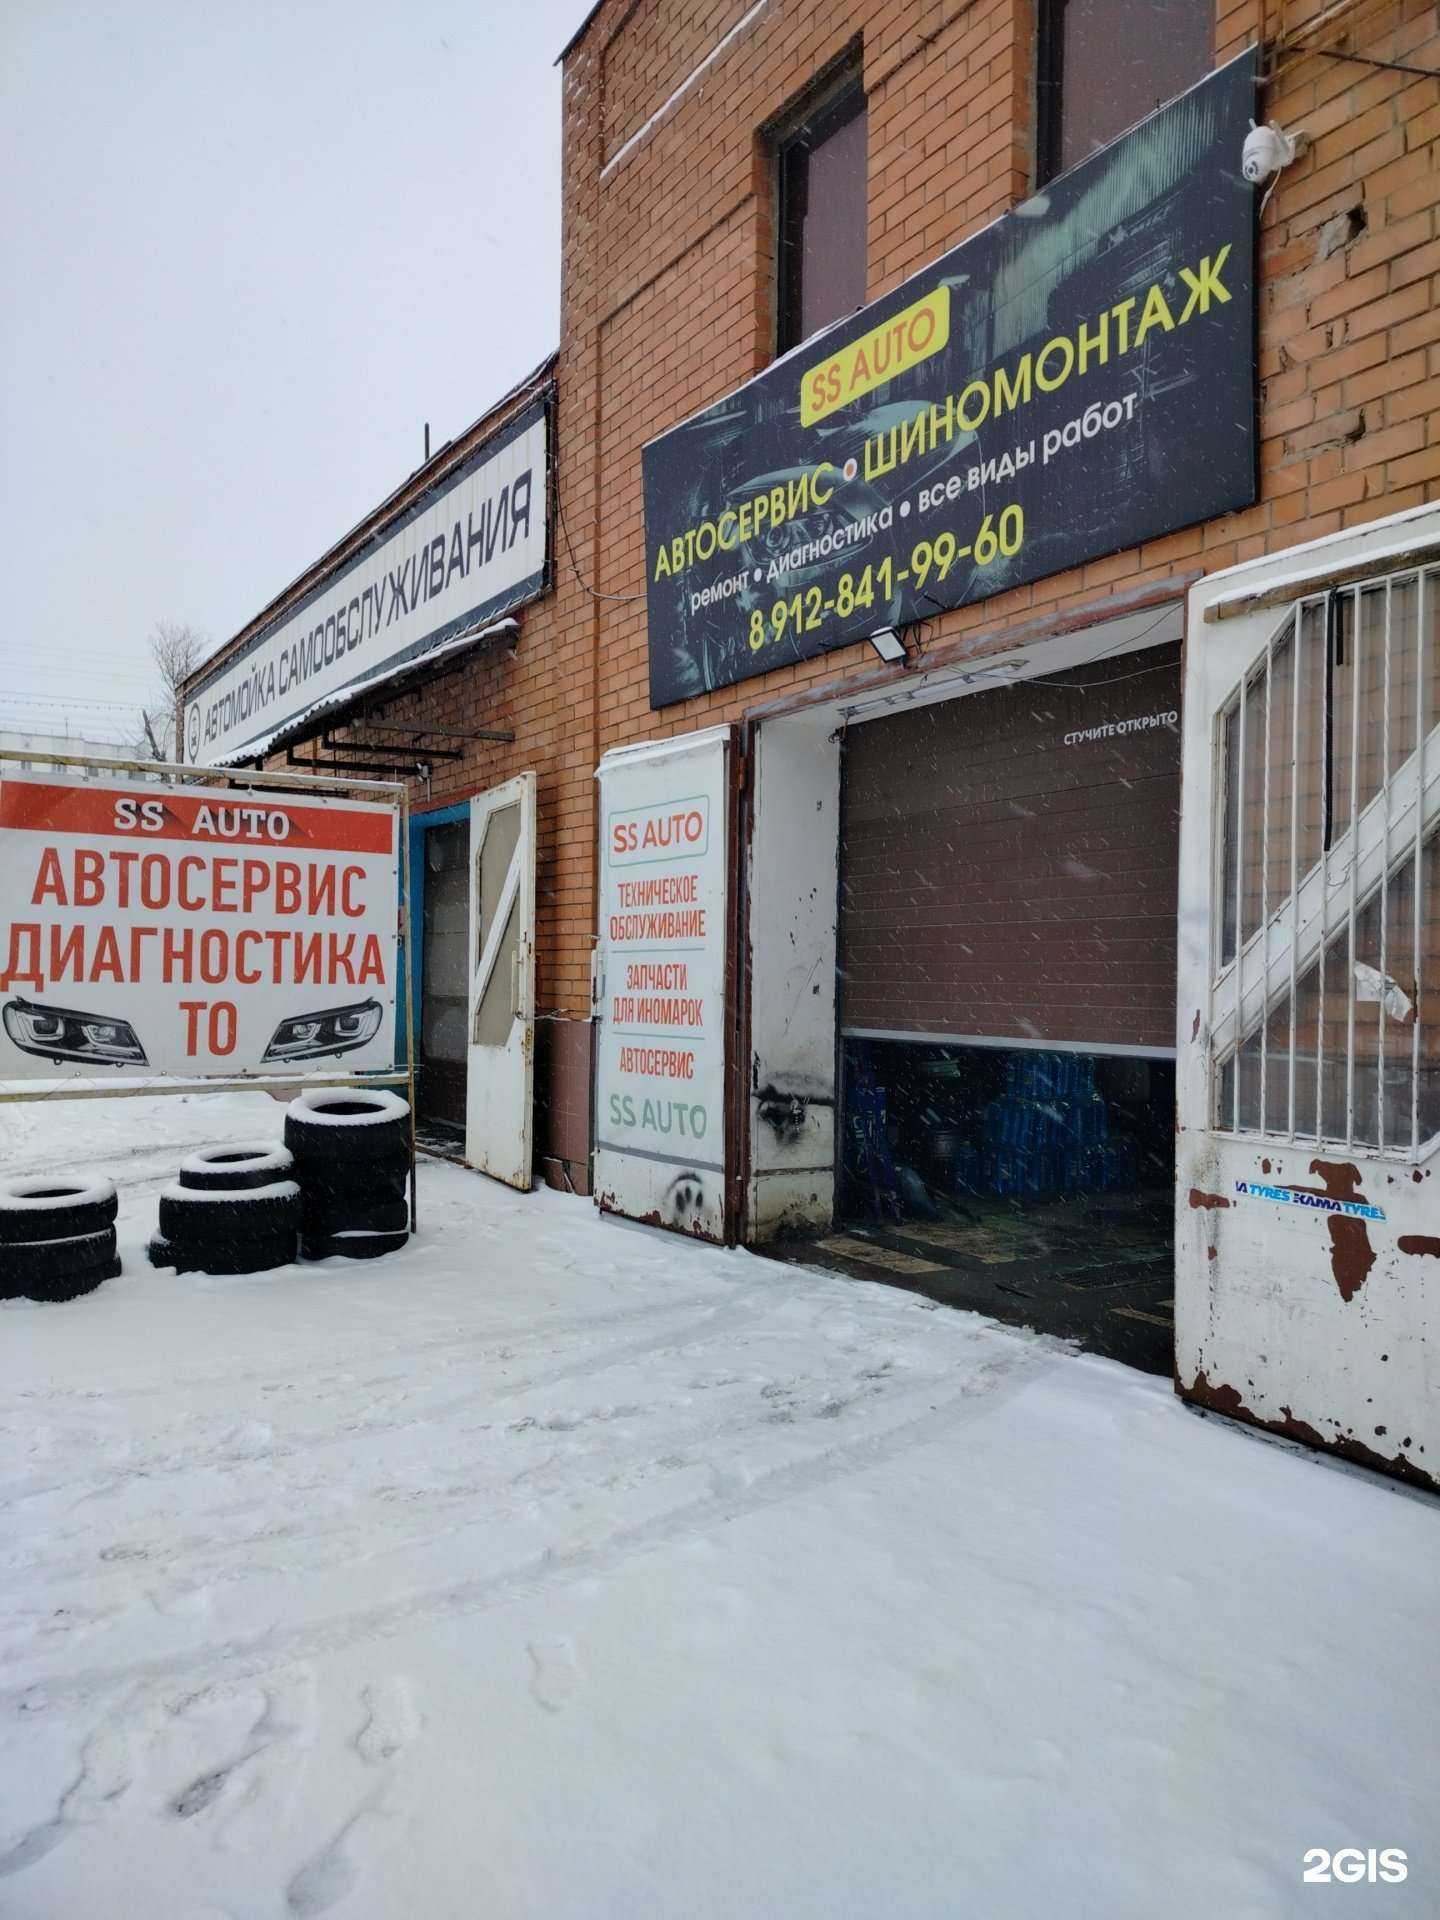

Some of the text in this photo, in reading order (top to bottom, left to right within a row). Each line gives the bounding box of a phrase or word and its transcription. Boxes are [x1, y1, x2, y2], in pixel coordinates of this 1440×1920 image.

[811, 306, 936, 413] SS AUTO
[654, 243, 1233, 582] АВТОСЕРВИС ШИНОМОНТАЖ
[691, 391, 1138, 616] ремонт диагностика все виды работ
[203, 468, 532, 746] АВТОМОЙКА САМООБСЛУЖИВАНИЯ
[1063, 710, 1178, 746] СТУЧИТЕ ОТКРЫТО
[113, 798, 290, 841] SS AUTO
[613, 811, 703, 853] SS AUTO
[31, 847, 367, 918] АВТОСЕРВИС
[617, 874, 698, 908] ТЕХНИЧЕСКОЕ
[610, 909, 706, 941] ОБСЛУЖИВАНИЕ
[0, 922, 386, 993] ДИАГНОСТИКА
[627, 963, 687, 991] ЗАПЧАСТИ
[179, 1001, 238, 1057] ТО
[613, 998, 703, 1027] ДЛЯ ИНОМАРОК
[620, 1046, 694, 1080] АВТОСЕРВИС
[610, 1093, 707, 1140] SS AUTO
[1249, 1183, 1290, 1201] TYRES
[1293, 1192, 1342, 1212] KAMA
